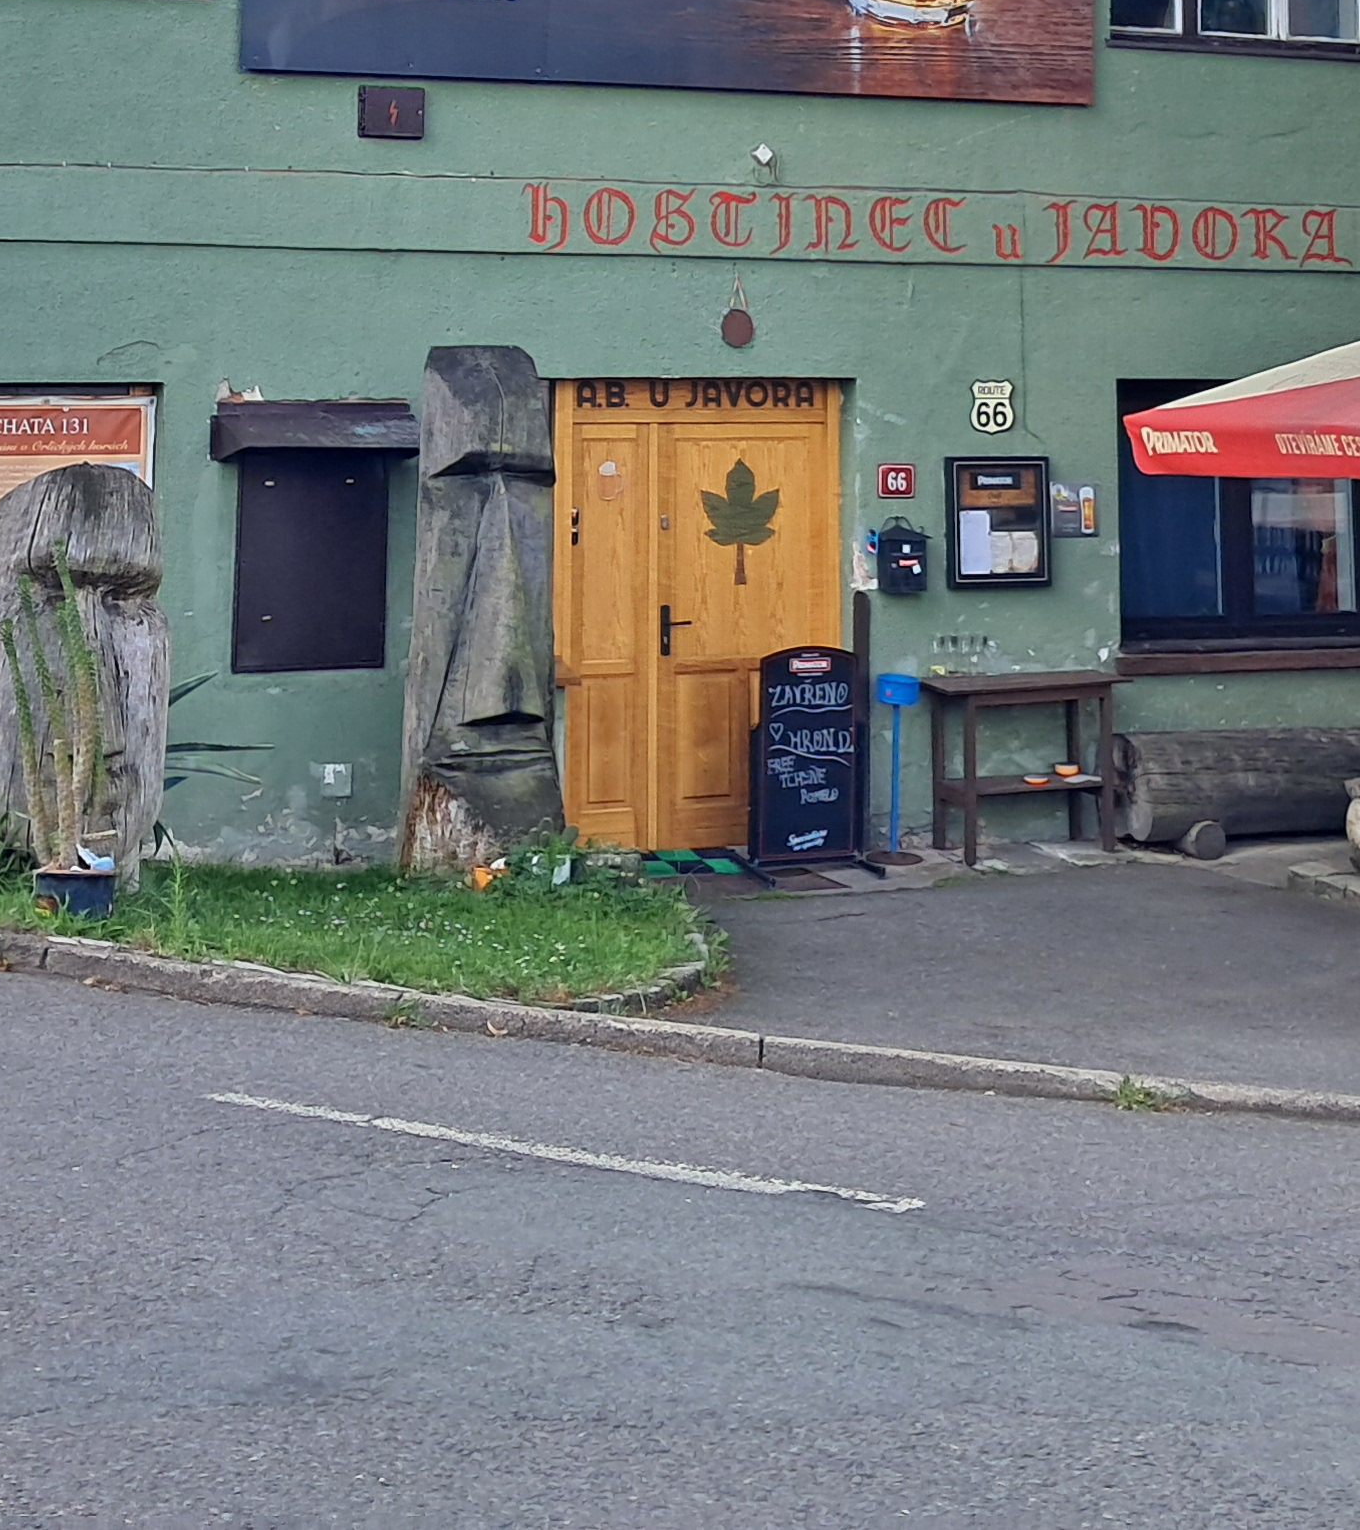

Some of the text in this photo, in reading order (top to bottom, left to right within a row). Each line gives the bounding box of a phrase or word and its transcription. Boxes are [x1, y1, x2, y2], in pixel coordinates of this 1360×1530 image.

[649, 380, 669, 408] U
[685, 380, 814, 408] JAVORA
[977, 385, 1007, 396] ROUTE
[61, 417, 89, 435] 131
[976, 402, 1007, 427] 66
[1141, 425, 1219, 456] PRIMATOR
[1274, 429, 1343, 456] OTEVÍRÁME
[887, 471, 907, 491] 66
[768, 678, 849, 707] ZAVŘENO
